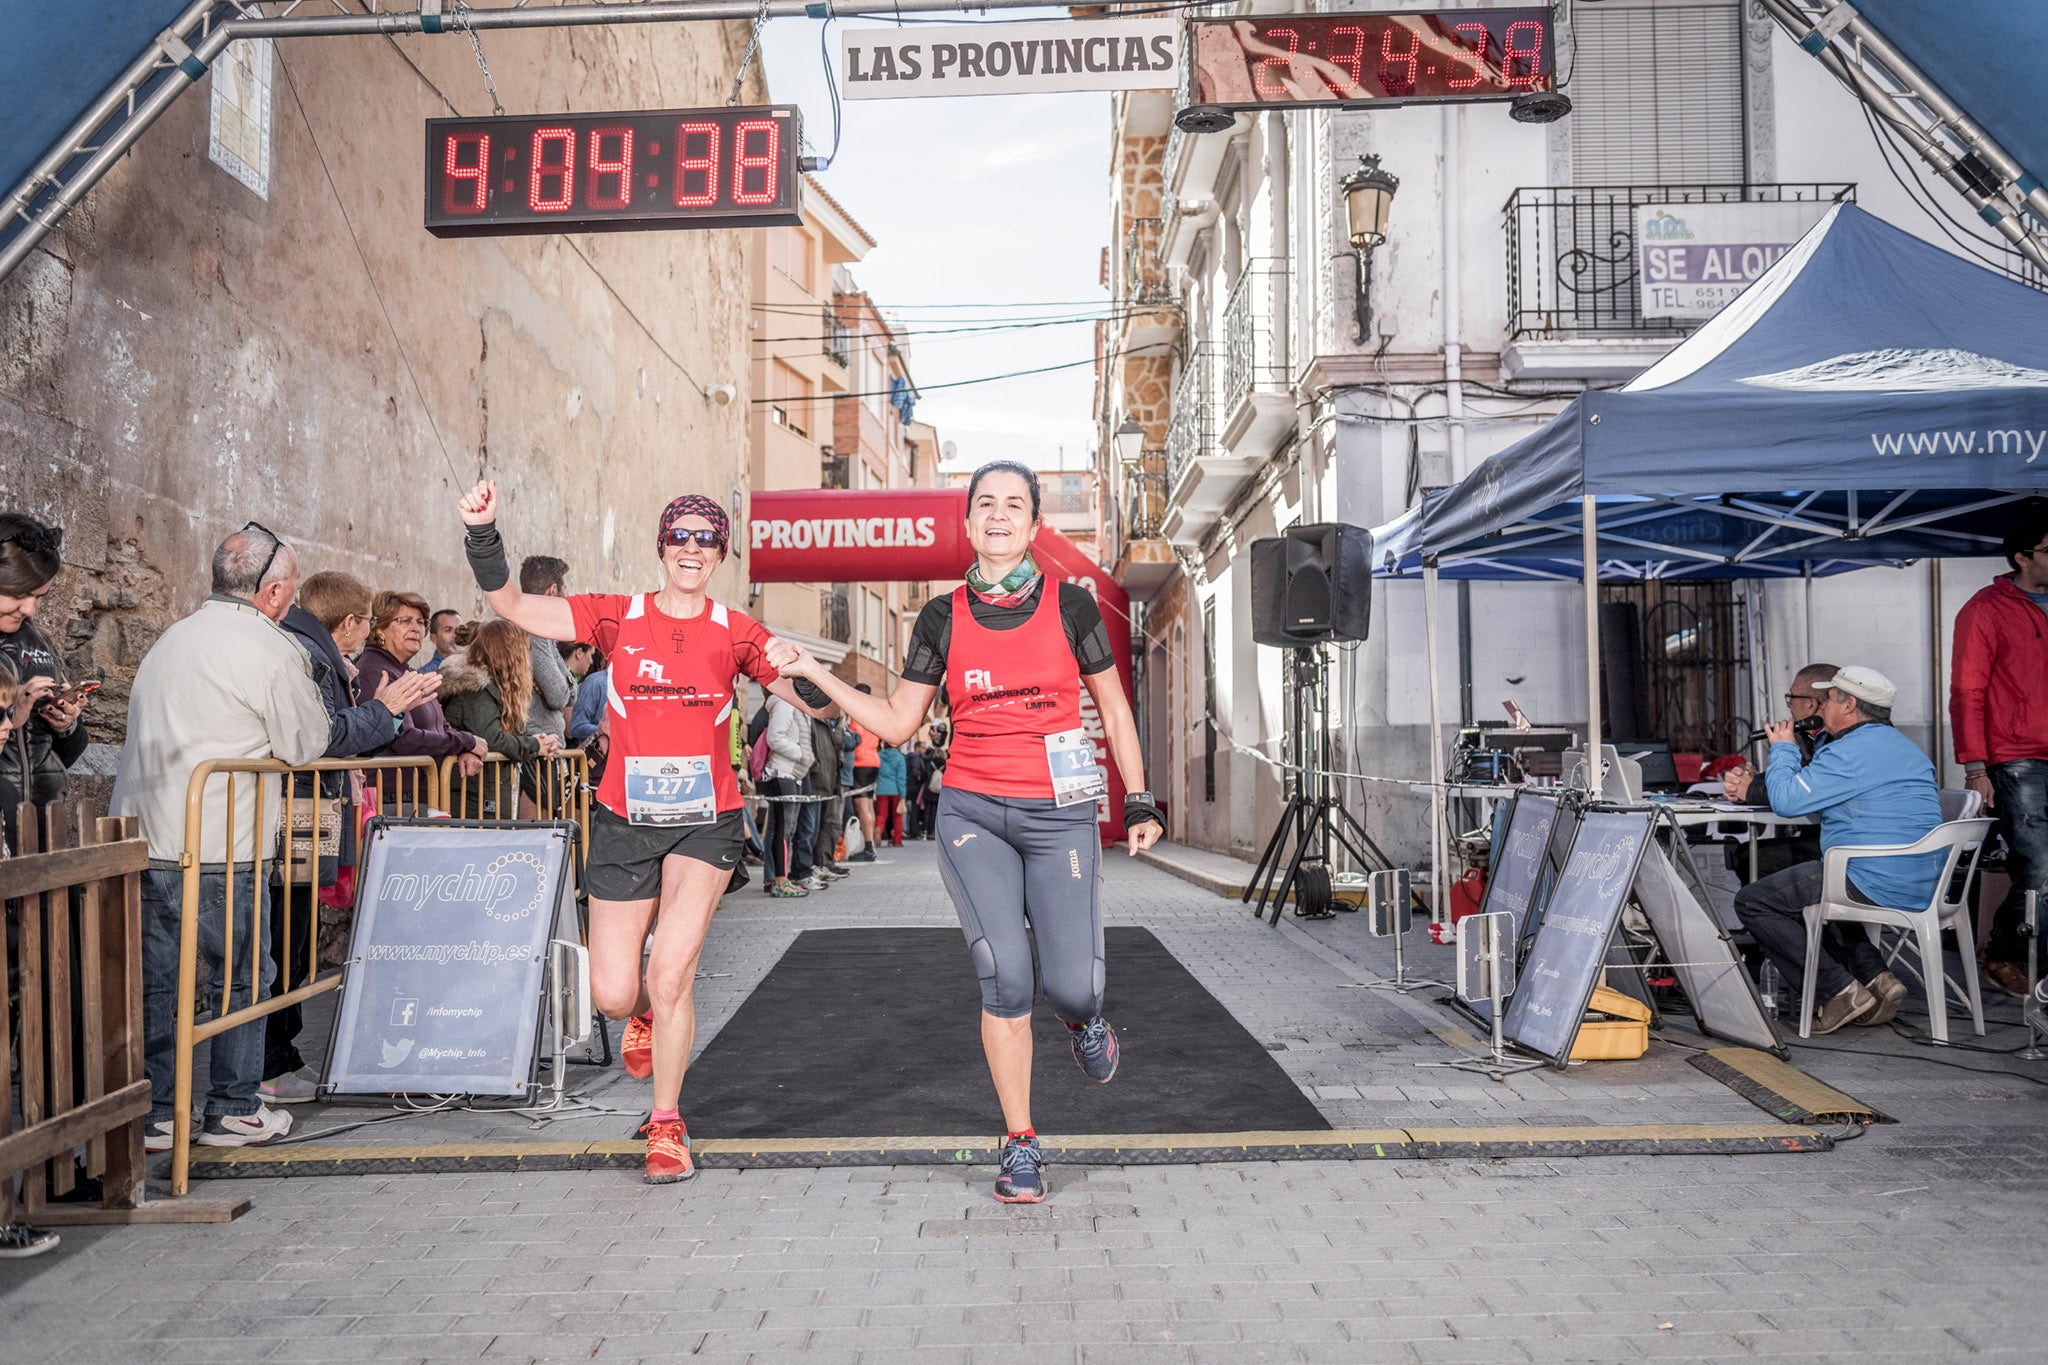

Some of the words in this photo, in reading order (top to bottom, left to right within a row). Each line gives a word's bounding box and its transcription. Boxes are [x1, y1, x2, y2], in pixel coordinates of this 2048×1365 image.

[848, 45, 922, 82] LAS
[931, 35, 1174, 79] PROVINCIAS
[1649, 248, 1687, 281] SE
[1702, 246, 1791, 282] ALQU
[1695, 288, 1724, 298] 651
[1696, 300, 1725, 310] 964
[1871, 430, 2047, 463] www.my
[751, 516, 936, 550] PROVINCIAS
[630, 684, 697, 696] ROMPIENDO
[971, 685, 1041, 703] ROMPIENDO
[682, 700, 714, 708] LIMITES
[1025, 700, 1056, 710] LIMITES
[1067, 748, 1097, 770] 12
[645, 776, 696, 796] 1277
[379, 863, 519, 911] mychip
[367, 940, 532, 966] www.mychip.es
[426, 1007, 483, 1019] /infomychip
[418, 1047, 487, 1060] @Mychip_Info
